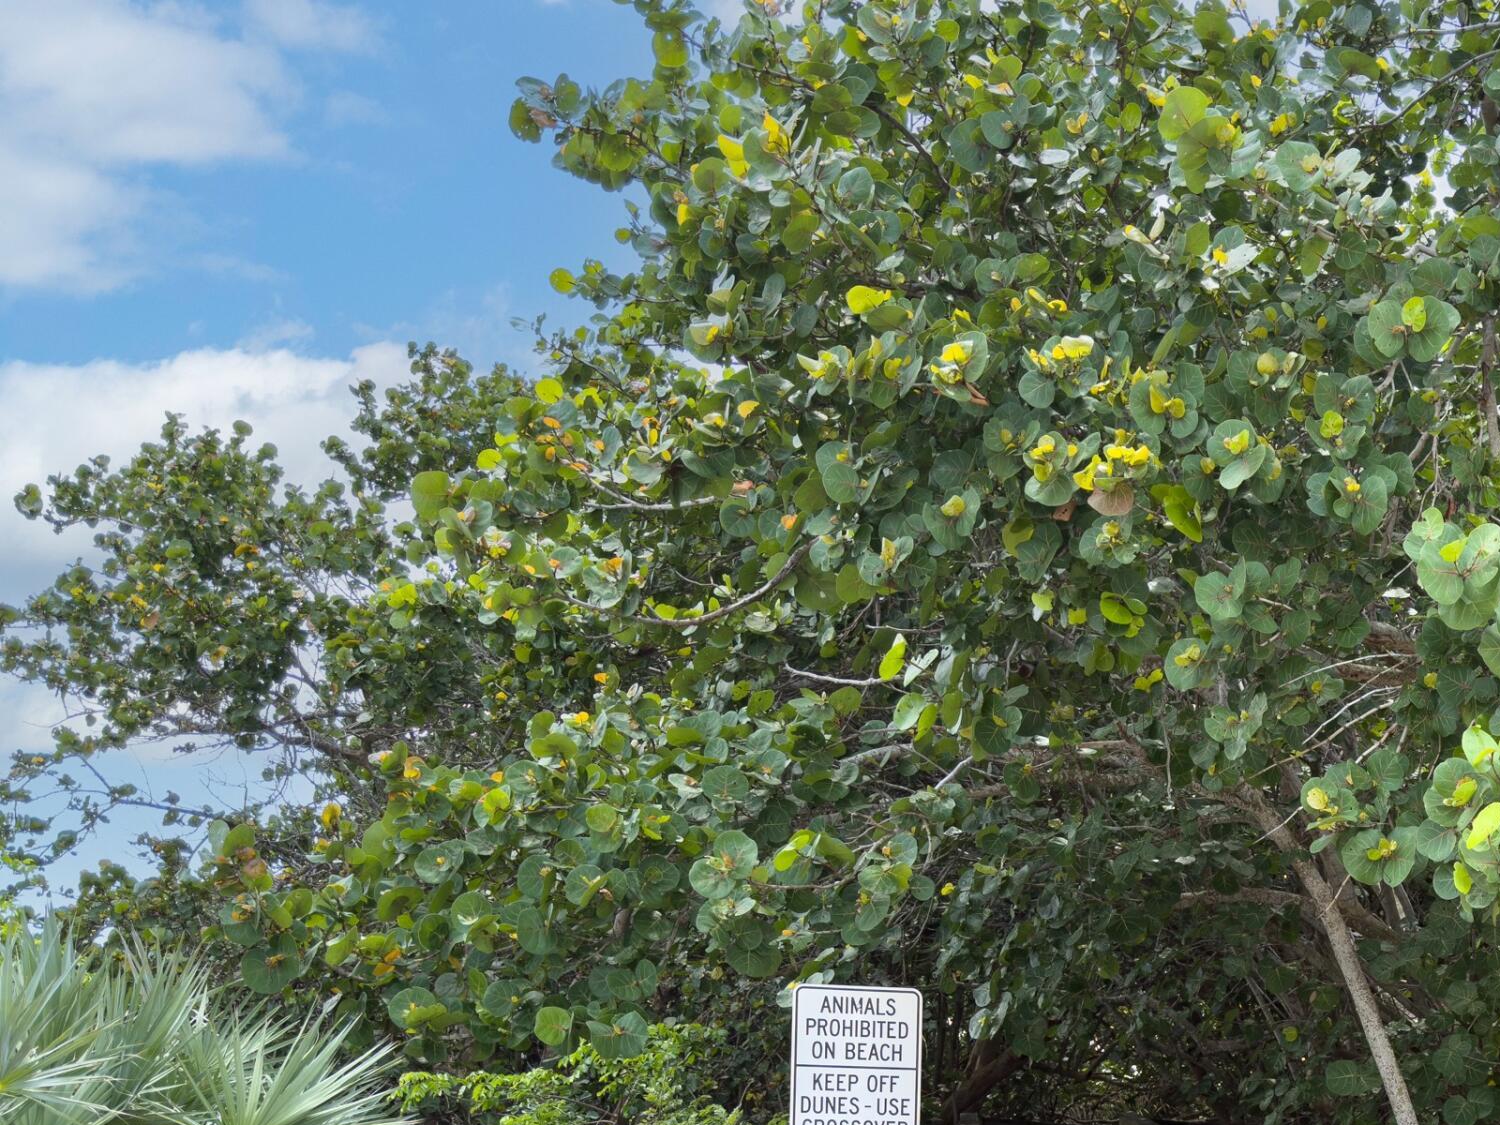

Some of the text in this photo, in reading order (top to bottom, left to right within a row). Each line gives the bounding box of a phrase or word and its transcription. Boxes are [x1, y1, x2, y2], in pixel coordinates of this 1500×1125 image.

[820, 996, 896, 1016] ANIMALS
[806, 1018, 909, 1039] PROHIBITED
[812, 1041, 902, 1062] ON BEACH
[812, 1073, 900, 1092] KEEP OFF
[800, 1096, 859, 1114] DUNES
[877, 1098, 910, 1116] USE
